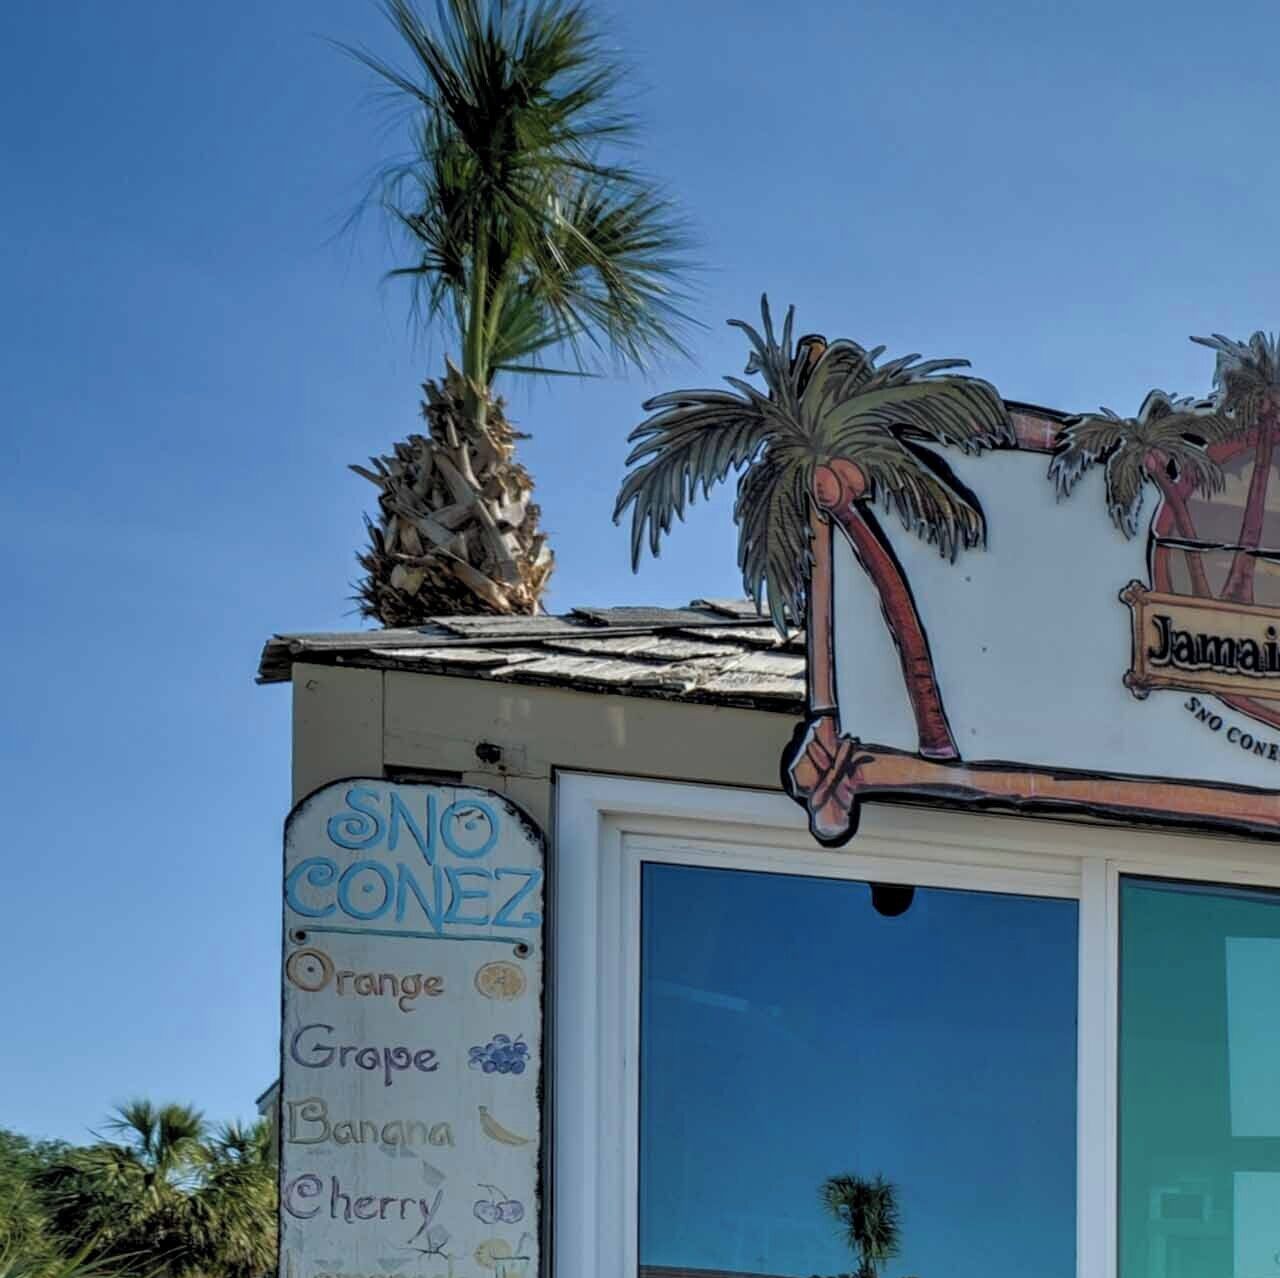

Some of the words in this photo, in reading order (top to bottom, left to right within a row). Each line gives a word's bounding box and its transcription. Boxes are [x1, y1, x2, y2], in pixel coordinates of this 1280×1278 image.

[1184, 697, 1223, 732] SNO
[327, 787, 498, 867] SNO
[286, 857, 541, 934] CONEZ
[286, 948, 444, 1012] Orange
[290, 1024, 440, 1088] Grape
[287, 1098, 455, 1147] Banana
[283, 1173, 443, 1245] Cherry
